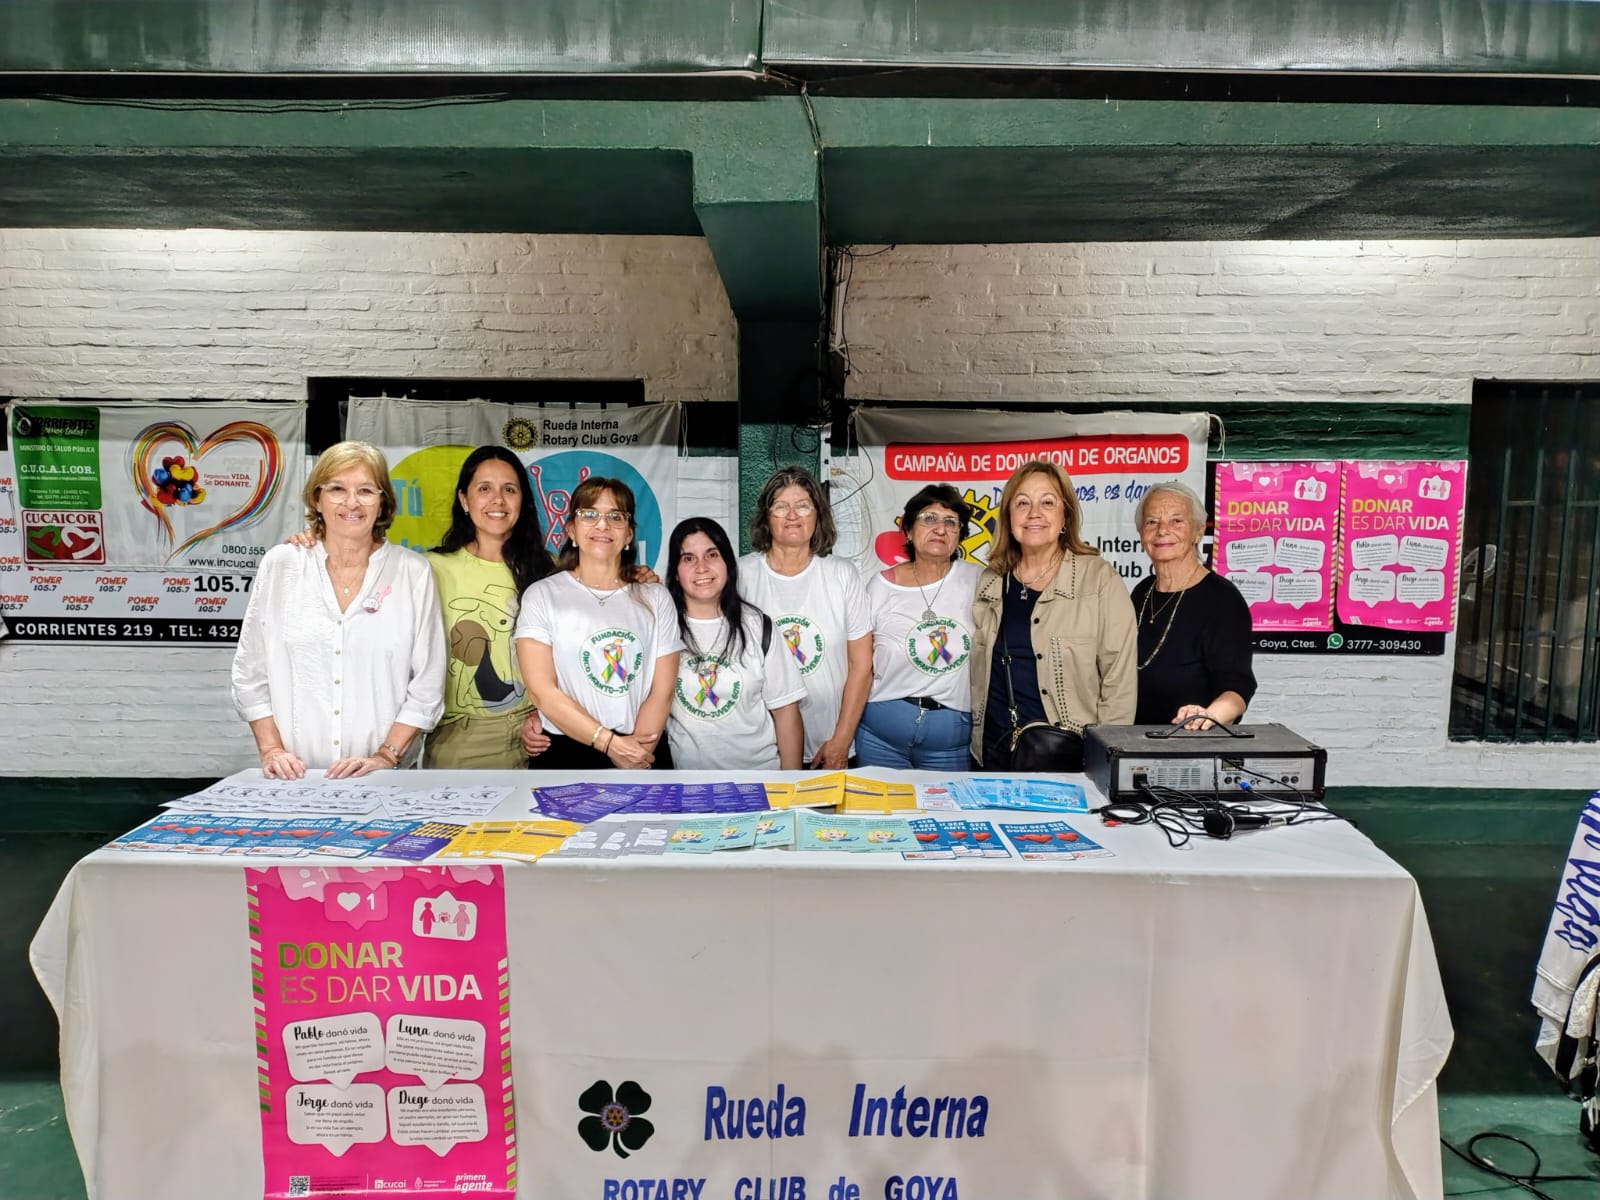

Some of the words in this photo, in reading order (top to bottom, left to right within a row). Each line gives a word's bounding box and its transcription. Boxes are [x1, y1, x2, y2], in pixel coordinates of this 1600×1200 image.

[543, 420, 577, 430] Rueda
[581, 420, 618, 430] Interna
[543, 434, 578, 448] Rotary
[582, 434, 608, 446] Club
[610, 432, 638, 446] Goya
[894, 453, 966, 472] CAMPAÑA
[971, 455, 990, 472] DE
[1078, 448, 1098, 466] DE
[1104, 446, 1180, 465] ORGANOS
[1104, 484, 1120, 500] es
[1228, 501, 1289, 515] DONAR
[1352, 498, 1413, 513] DONAR
[26, 512, 97, 524] CUCAICOR
[1228, 518, 1246, 532] ES
[1250, 518, 1281, 532] DAR
[1285, 518, 1326, 532] VIDA
[1352, 516, 1370, 530] ES
[1374, 516, 1406, 530] DAR
[1408, 516, 1450, 530] VIDA
[222, 545, 247, 554] 0800
[1098, 536, 1145, 552] Inter
[30, 576, 62, 584] POWER
[96, 576, 128, 585] POWER
[163, 578, 190, 586] POWE
[194, 576, 253, 592] 105.7
[62, 596, 94, 604] POWER
[128, 596, 160, 604] POWER
[194, 597, 228, 606] POWER
[775, 616, 810, 628] UNDACIÓN
[16, 623, 117, 636] CORRIENTES
[123, 624, 152, 636] 219
[169, 625, 202, 637] TEL:
[208, 626, 239, 638] 432
[591, 630, 636, 644] FUNDACIÓN
[1260, 638, 1289, 650] Goya,
[1292, 640, 1317, 648] Ctes.
[1347, 640, 1421, 650] 3777-309430
[366, 892, 375, 910] 1
[278, 941, 404, 969] DONAR
[280, 976, 318, 1004] ES
[327, 976, 392, 1004] DAR
[397, 974, 483, 1001] VIDA
[294, 1026, 325, 1040] Pablo
[326, 1028, 348, 1038] donó
[350, 1026, 368, 1035] vida
[398, 1018, 430, 1038] Luna
[433, 1030, 456, 1040] donó
[458, 1034, 476, 1042] vida
[297, 1092, 330, 1112] Jorge
[330, 1100, 354, 1108] donó
[355, 1100, 374, 1108] vida
[398, 1090, 430, 1109] Diego
[432, 1096, 454, 1104] donó
[455, 1096, 474, 1104] vida
[704, 1083, 807, 1141] Rueda
[848, 1083, 988, 1139] Interna
[462, 1181, 492, 1194] gente
[603, 1177, 706, 1200] ROTARY
[734, 1176, 806, 1200] CLUB
[828, 1176, 860, 1200] de
[884, 1176, 958, 1200] GOYA
